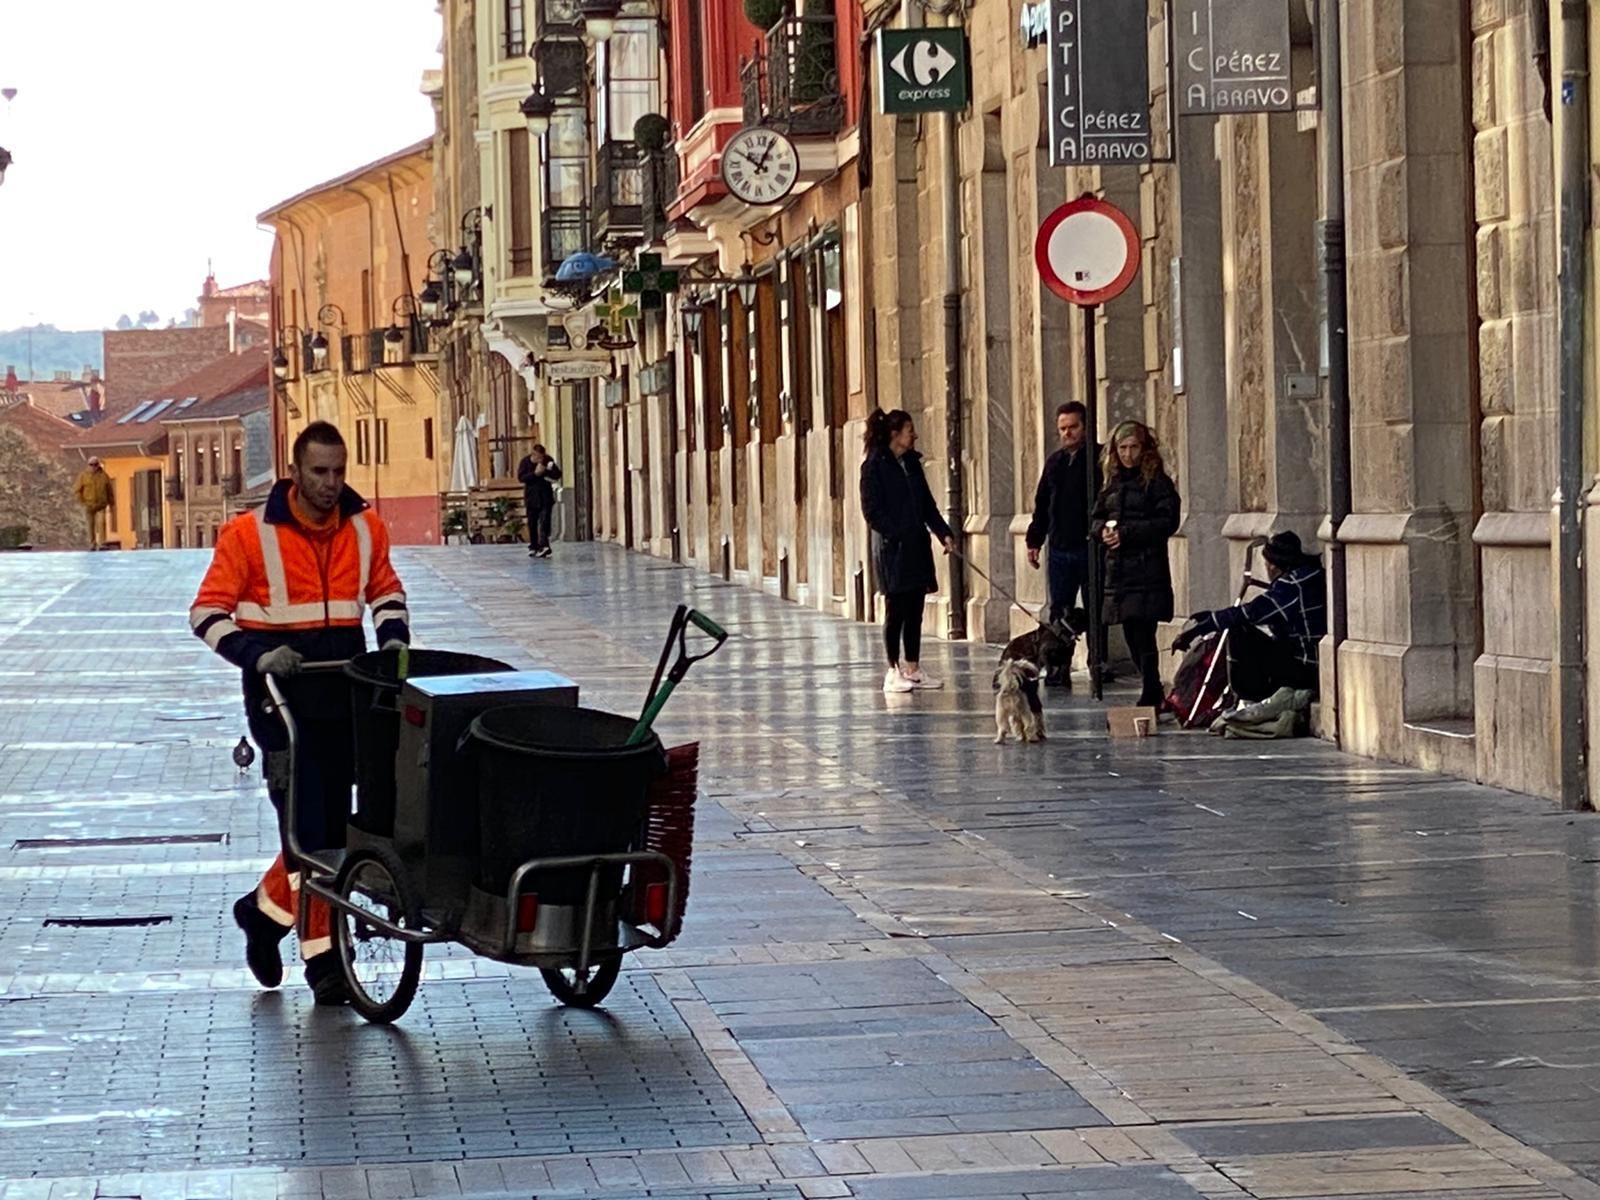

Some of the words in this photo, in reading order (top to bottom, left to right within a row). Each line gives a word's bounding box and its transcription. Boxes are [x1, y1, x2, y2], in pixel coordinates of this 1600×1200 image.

[1215, 50, 1281, 73] PÉREZ
[1058, 0, 1077, 160] PTICA
[898, 87, 951, 102] express
[1216, 87, 1289, 106] BRAVO
[1084, 110, 1141, 130] PÉREZ
[1085, 142, 1148, 160] BRAVO
